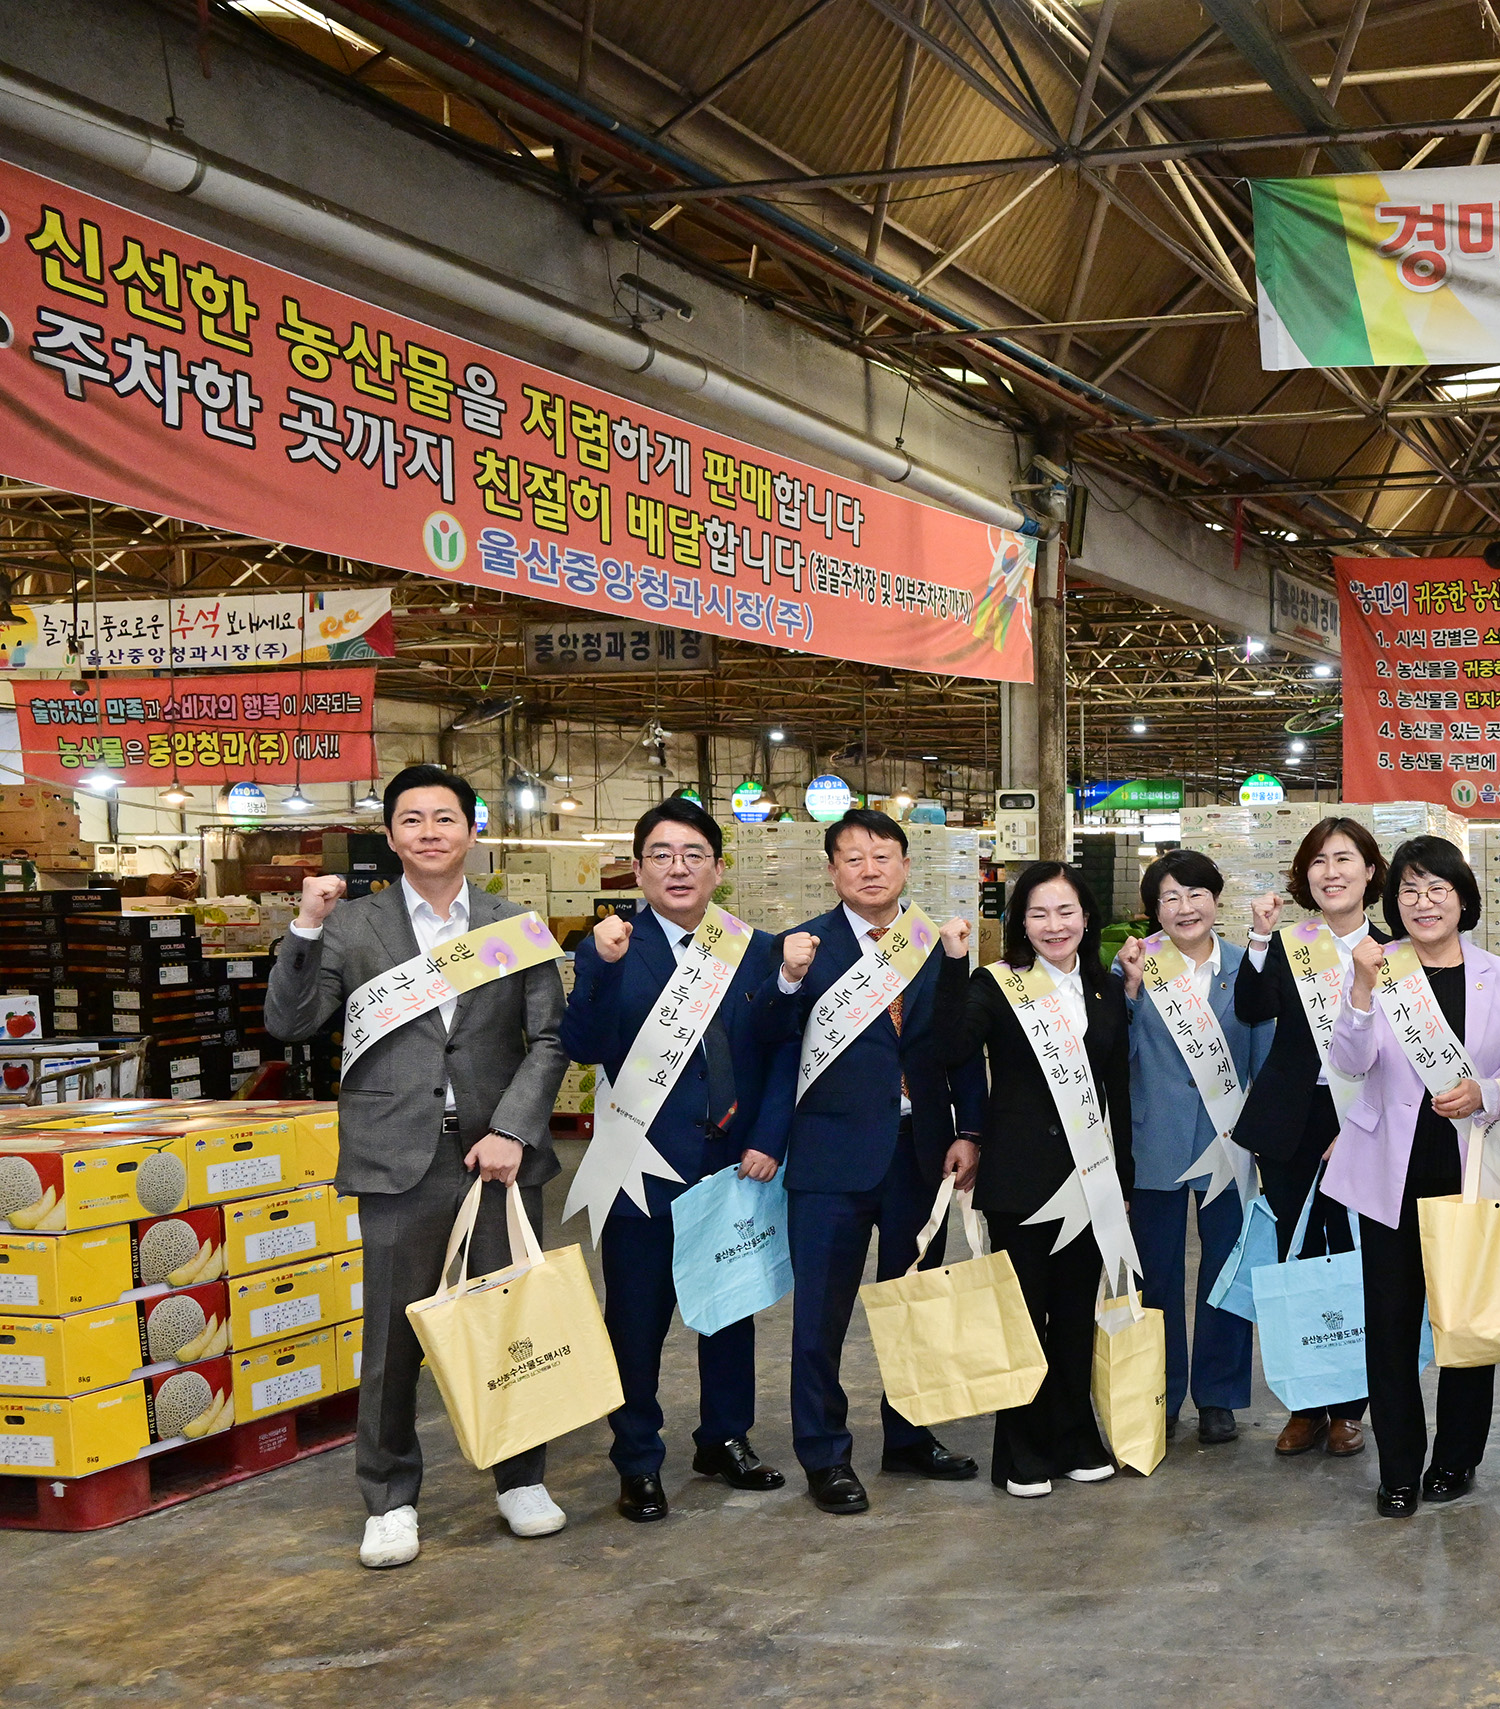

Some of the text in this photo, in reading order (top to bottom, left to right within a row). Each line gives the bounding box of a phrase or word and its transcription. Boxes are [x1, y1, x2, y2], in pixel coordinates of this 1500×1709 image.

[27, 205, 865, 548] 신선한 농산물을 저렴하게 판매합니다
[32, 308, 974, 626] 주차한 곳까지 친절히 배달합니다 (철골주차장 및 외부주차장까지)
[476, 526, 814, 642] 울산중앙청과시장(주)
[1413, 581, 1466, 615] 귀중한
[100, 613, 164, 640] 풍요로운
[172, 602, 222, 639] 추석
[226, 609, 295, 636] 보내세요
[1279, 580, 1338, 637] 중앙청과경매
[1376, 631, 1391, 648] 1.
[1396, 629, 1426, 648] 시식
[1432, 628, 1478, 647] 감별은
[1376, 660, 1392, 678] 2.
[1397, 660, 1458, 679] 농산물을
[30, 692, 362, 725] 출하자의 만족과 소비자의 행복이 시작되는
[1378, 690, 1394, 708] 3.
[1397, 690, 1458, 709] 농산물을
[1379, 721, 1394, 739] 4.
[1399, 720, 1444, 740] 농산물
[1449, 722, 1481, 741] 있는
[57, 736, 145, 769] 농산물은
[1378, 753, 1394, 771] 5.
[1399, 751, 1443, 771] 농산물
[1448, 752, 1496, 772] 주변에
[341, 1027, 370, 1068] 되세
[1440, 1043, 1473, 1079] 되세
[140, 1316, 148, 1357] PREMIUM
[1301, 1327, 1365, 1345] 울산농수산물도매시
[487, 1344, 571, 1391] 울산농수산물도매시장
[147, 1394, 156, 1435] PREMIUM
